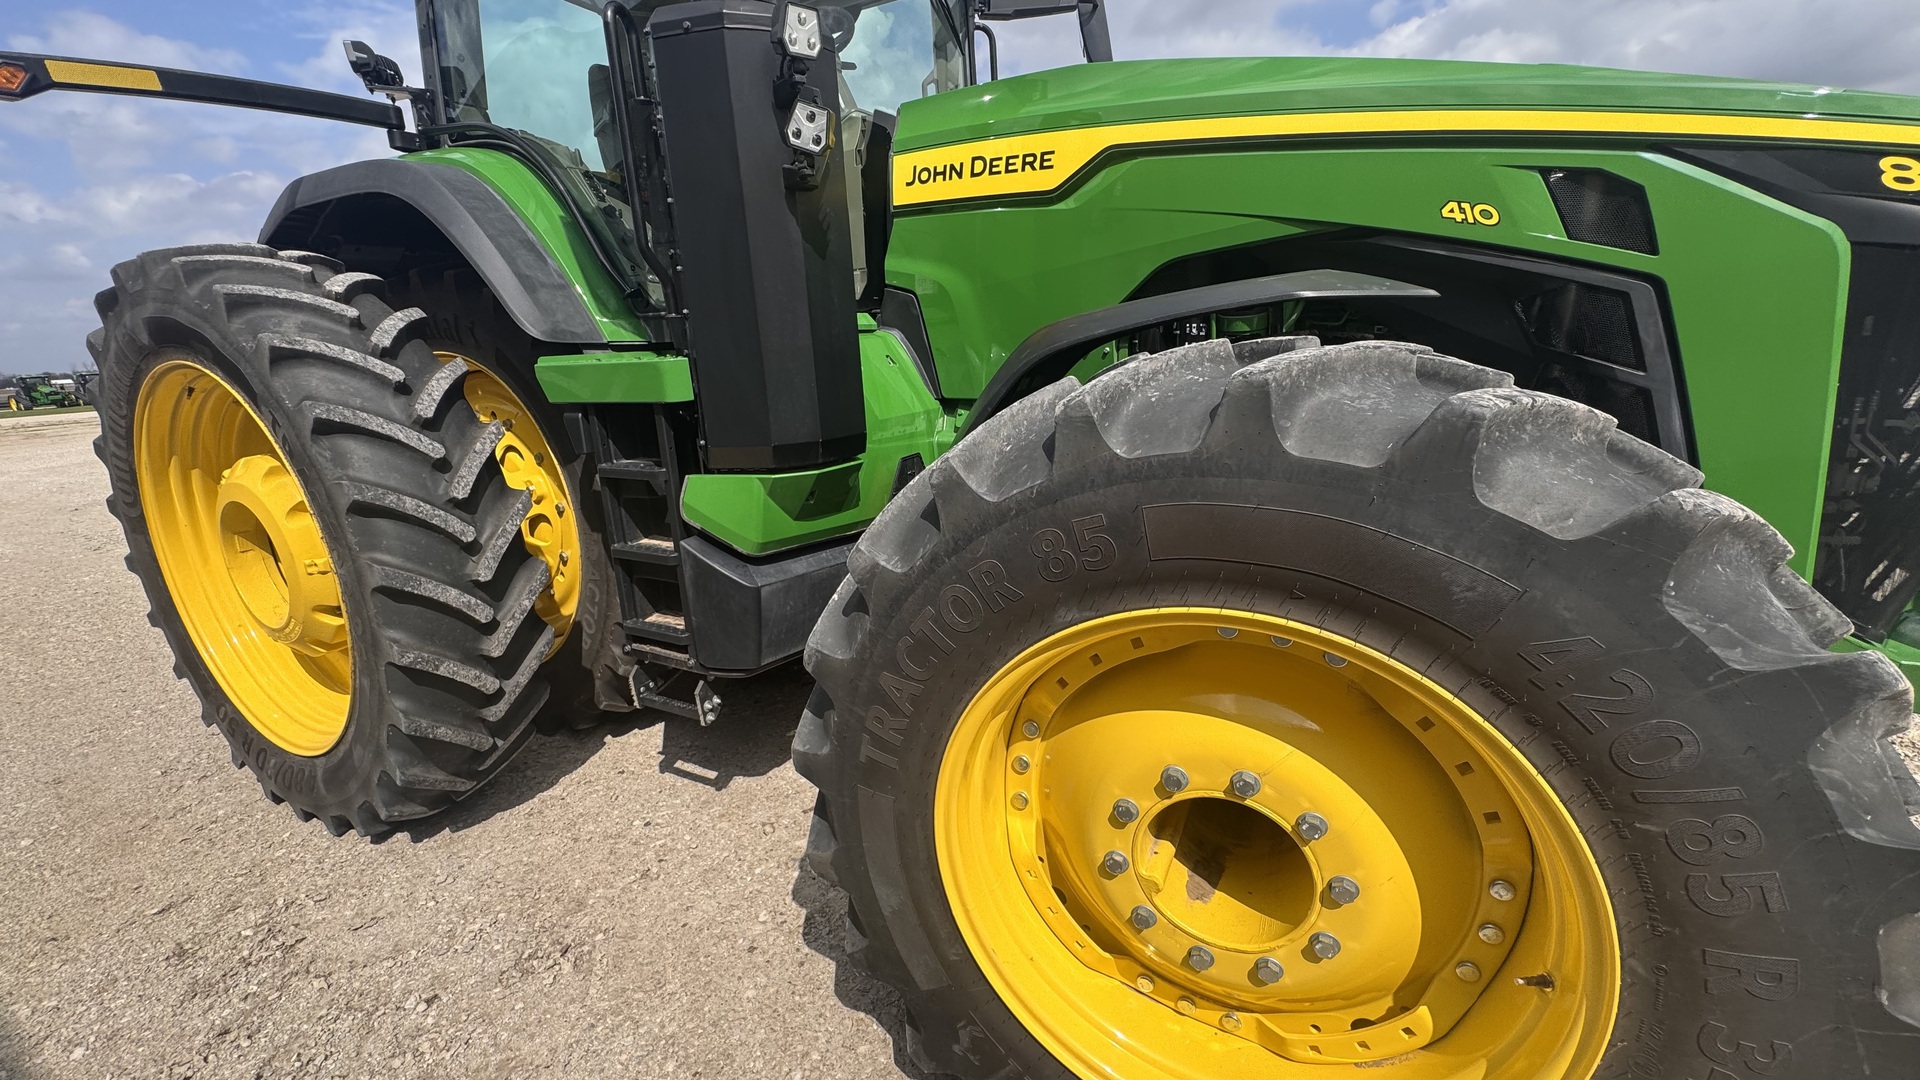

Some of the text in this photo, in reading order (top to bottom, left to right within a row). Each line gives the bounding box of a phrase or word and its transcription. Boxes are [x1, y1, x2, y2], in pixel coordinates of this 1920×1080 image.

[905, 150, 1056, 187] JOHN DEERE
[1878, 156, 1920, 192] 8
[1439, 200, 1501, 227] 410
[859, 513, 1118, 770] TRACTOR 85
[1517, 636, 1790, 918] 420/85
[1703, 947, 1800, 1001] R
[1697, 1020, 1794, 1080] 3
